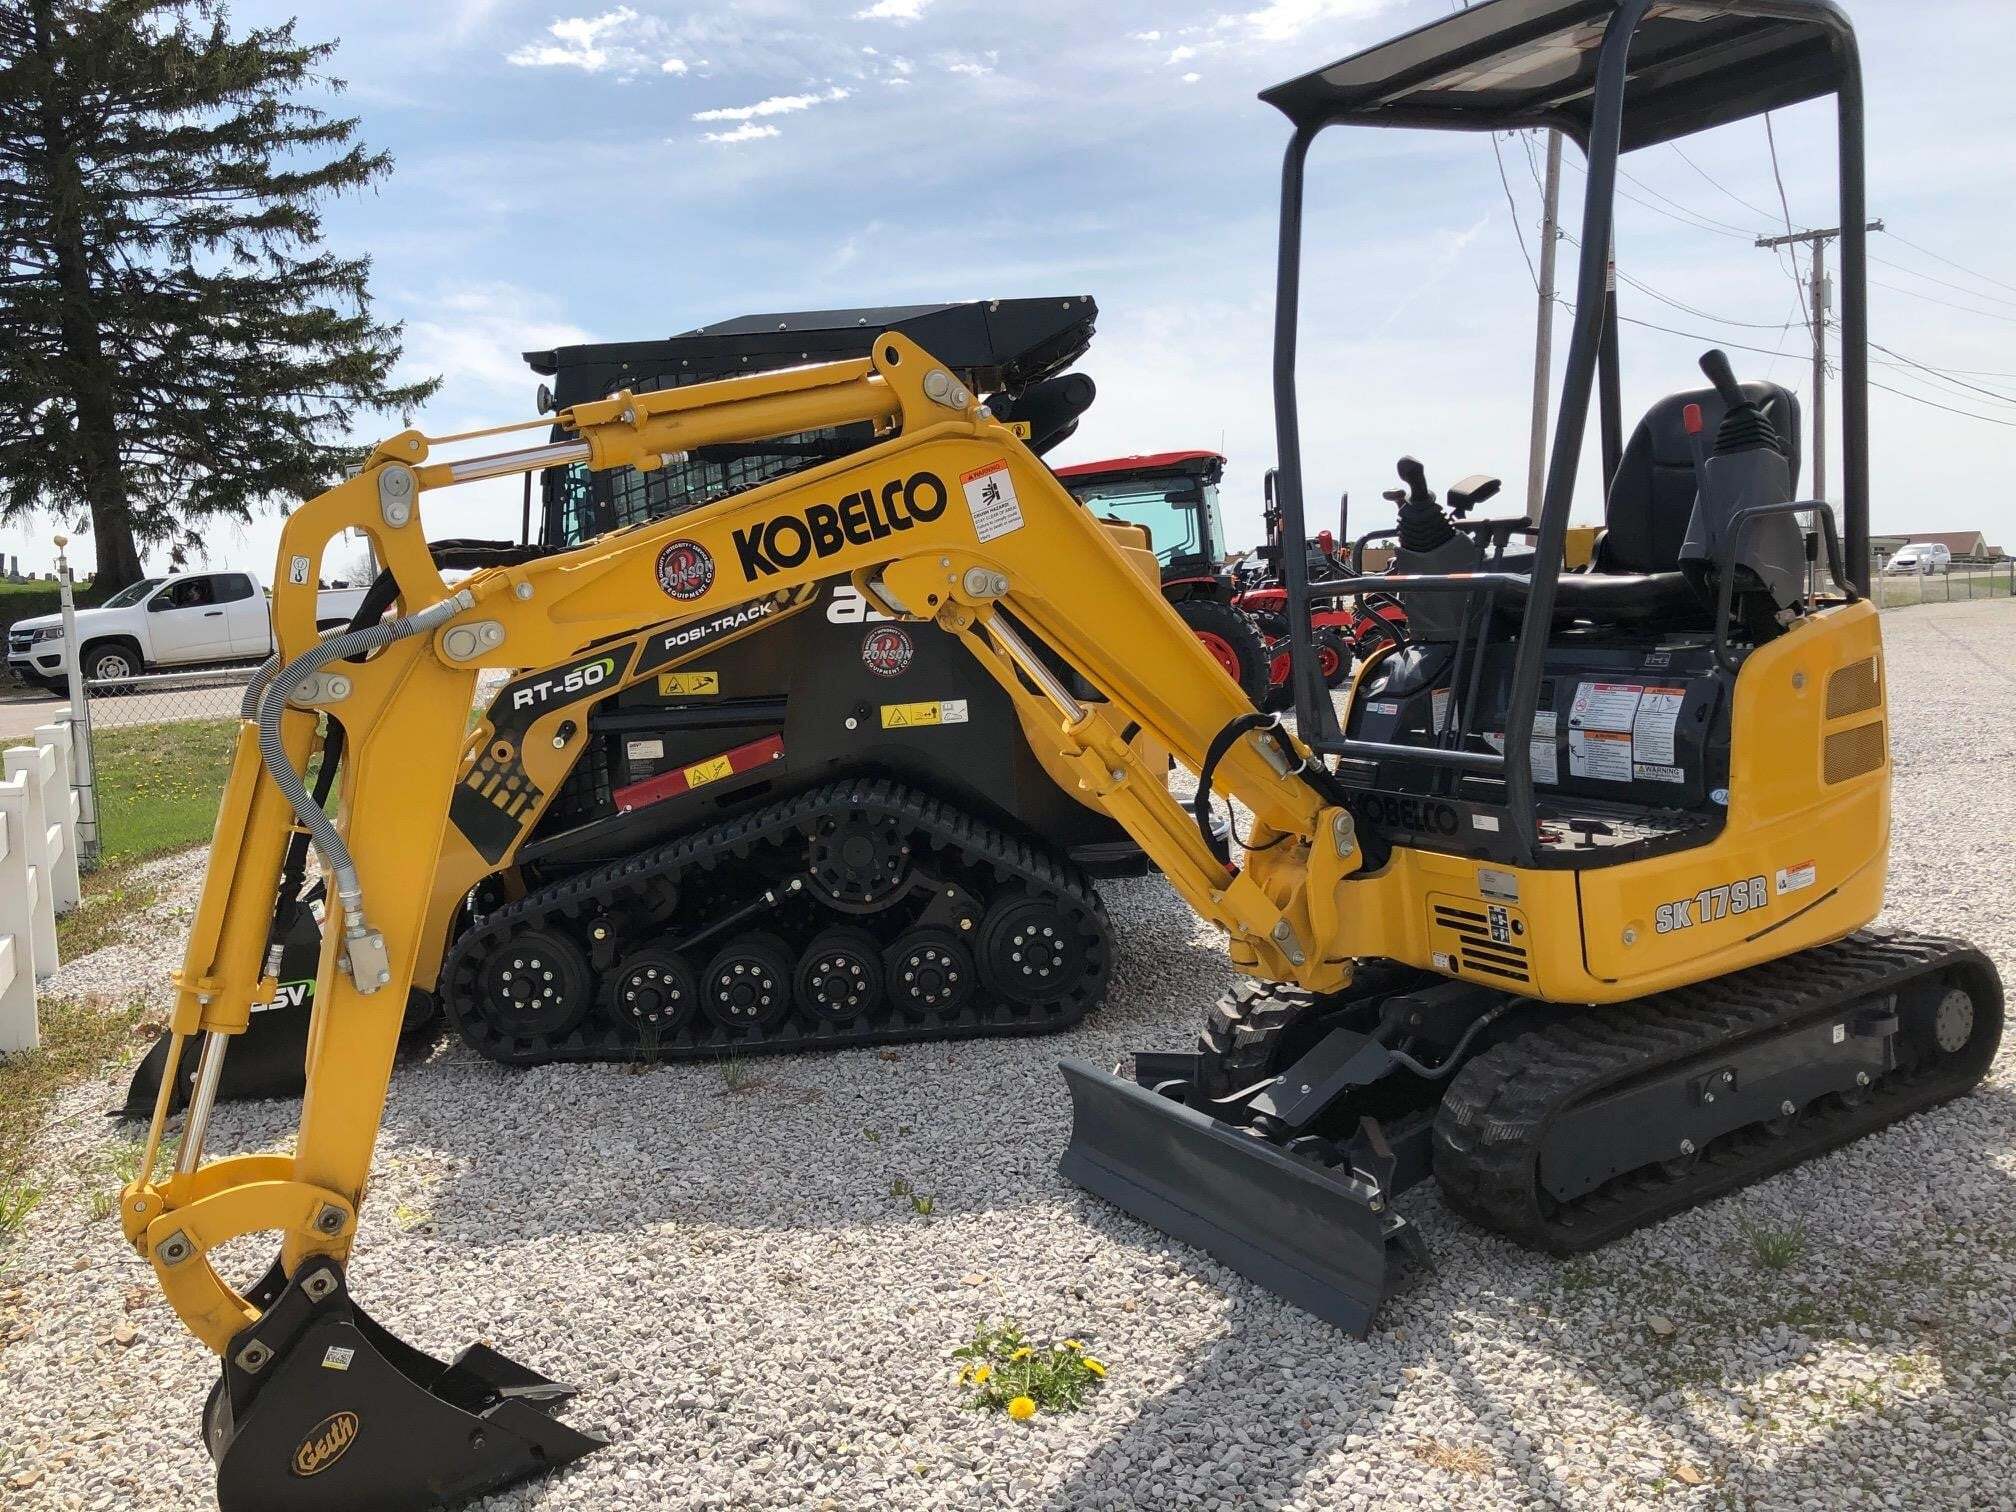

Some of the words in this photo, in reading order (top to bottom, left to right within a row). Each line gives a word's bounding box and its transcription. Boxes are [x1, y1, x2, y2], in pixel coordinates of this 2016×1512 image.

[731, 471, 948, 583] KOBELCO
[667, 584, 708, 599] EQUIPMENT
[664, 602, 773, 650] POSI-TRACK
[862, 649, 914, 660] RONSON
[513, 664, 604, 710] RT-50
[1645, 766, 1680, 775] WARNING
[1655, 875, 1769, 935] SK17SR
